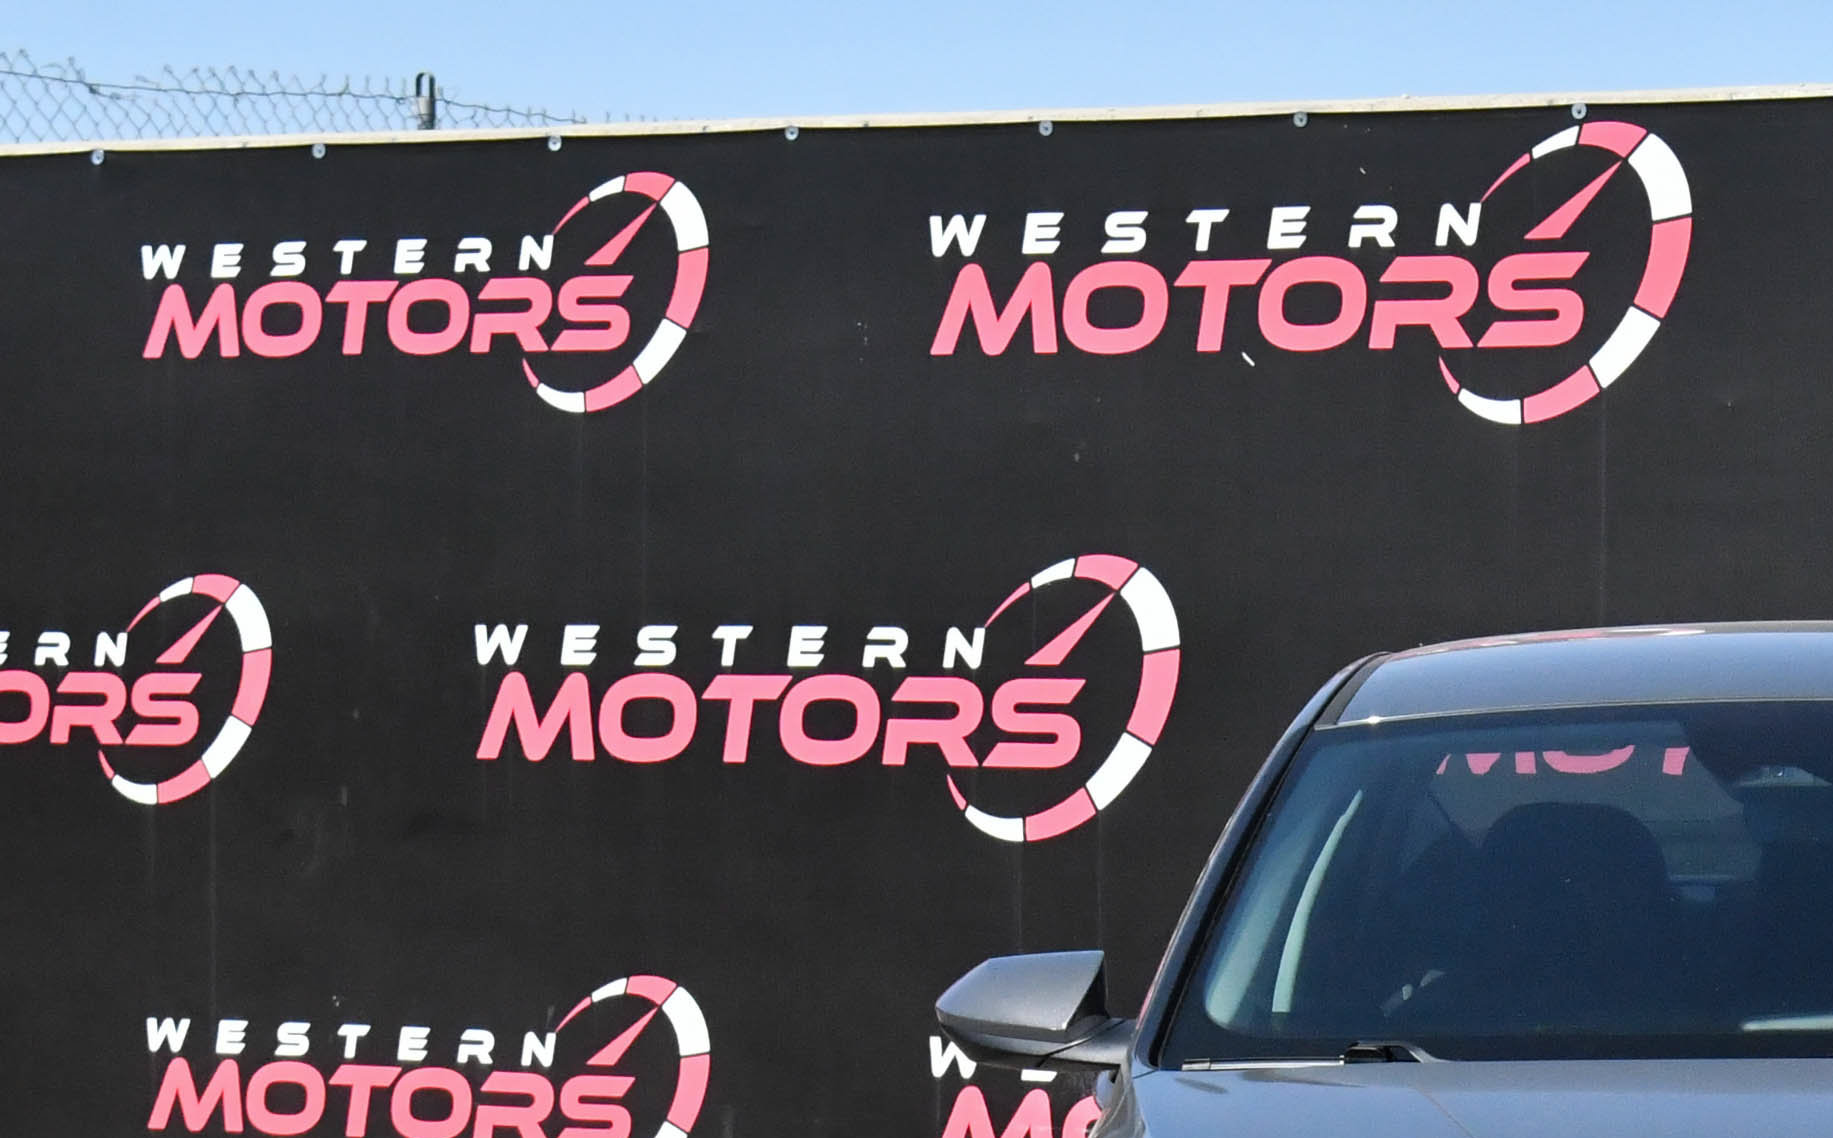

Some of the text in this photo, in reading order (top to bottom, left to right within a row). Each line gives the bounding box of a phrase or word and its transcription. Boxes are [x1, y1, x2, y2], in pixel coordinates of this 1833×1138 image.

[141, 234, 555, 280] WESTERN
[929, 201, 1483, 258] WESTERN
[143, 274, 634, 359] MOTORS
[930, 251, 1590, 356] MOTORS
[474, 622, 986, 670] WESTERN
[476, 671, 1086, 769] MOTORS
[146, 1016, 557, 1068] WESTERN
